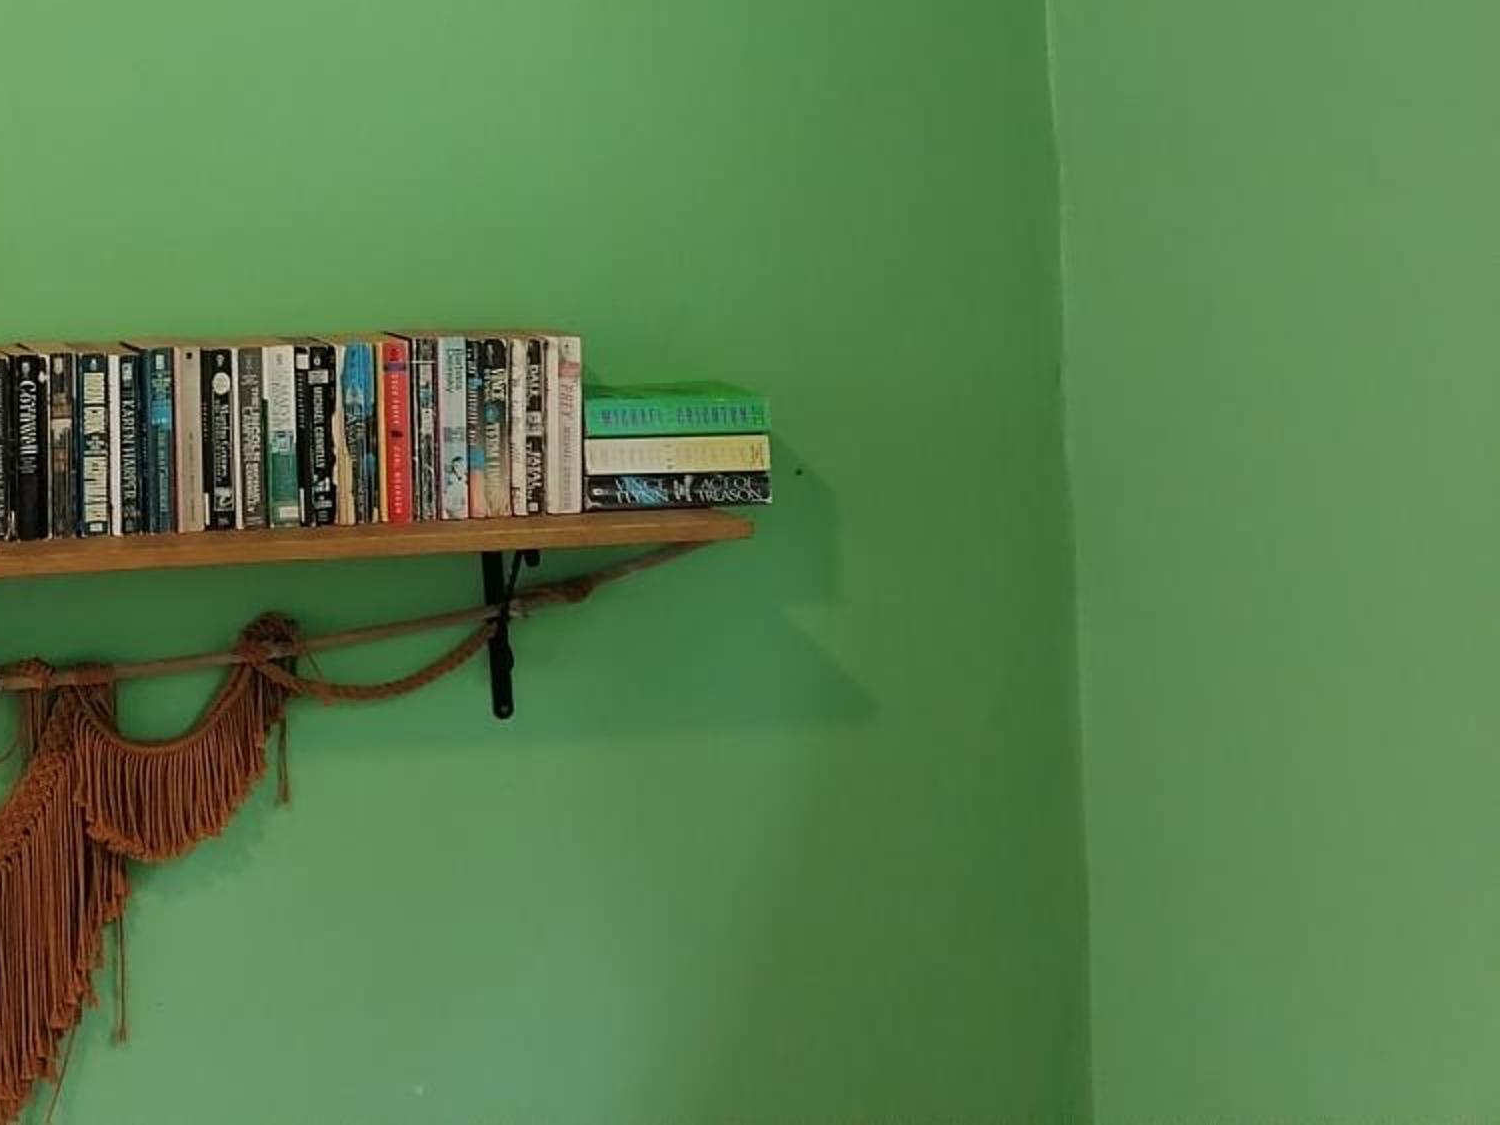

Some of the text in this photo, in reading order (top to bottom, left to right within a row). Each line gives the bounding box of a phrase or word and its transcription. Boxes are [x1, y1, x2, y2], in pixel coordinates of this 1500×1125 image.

[528, 363, 539, 397] DALE
[559, 384, 574, 419] PREY
[313, 386, 325, 468] MICHAEL CONNELLY
[121, 399, 137, 500] KAREN HARPER
[614, 476, 665, 490] VINCE
[699, 489, 764, 503] TREASON
